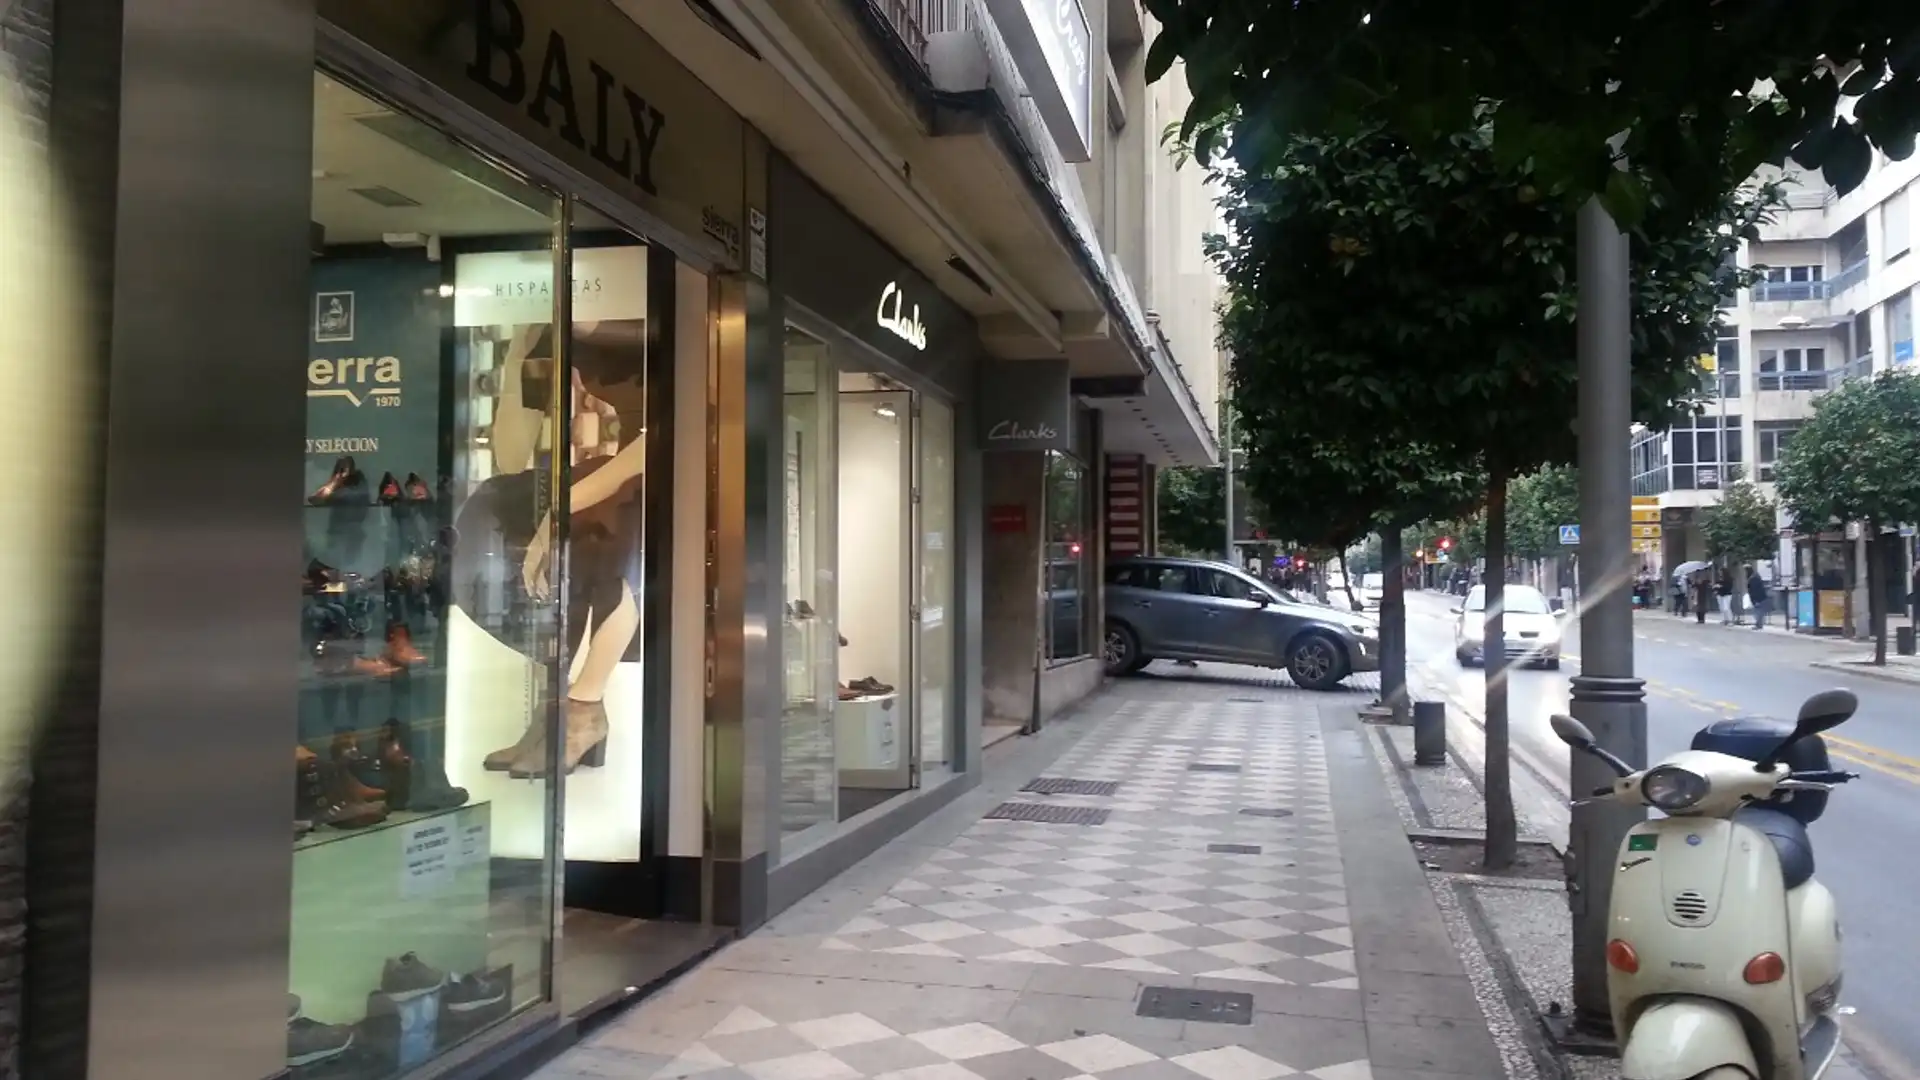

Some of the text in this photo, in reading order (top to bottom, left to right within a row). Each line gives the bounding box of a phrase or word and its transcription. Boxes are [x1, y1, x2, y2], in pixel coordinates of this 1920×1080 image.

[876, 281, 927, 351] Clarks
[376, 396, 401, 407] 1970
[988, 420, 1057, 441] Clarks
